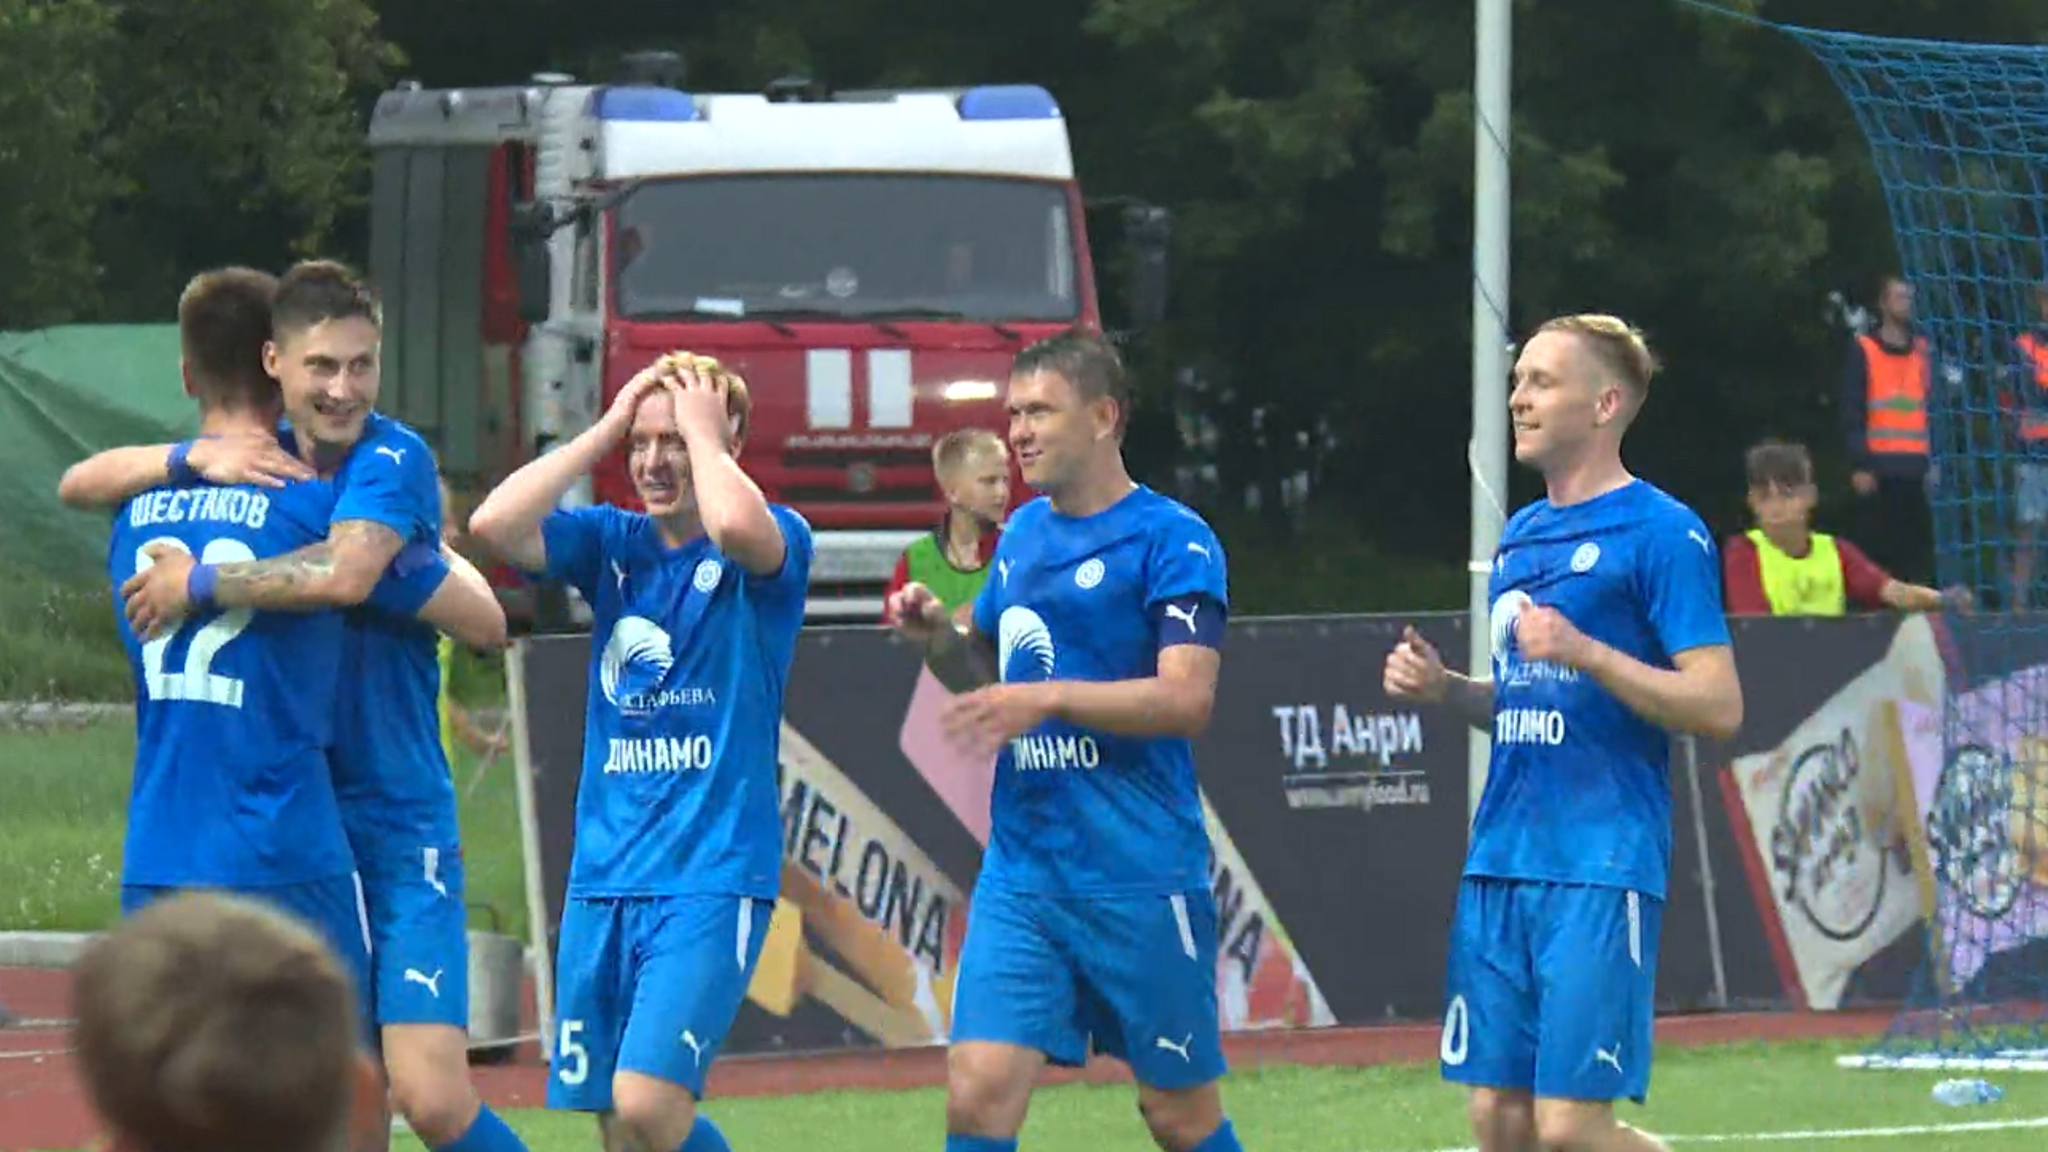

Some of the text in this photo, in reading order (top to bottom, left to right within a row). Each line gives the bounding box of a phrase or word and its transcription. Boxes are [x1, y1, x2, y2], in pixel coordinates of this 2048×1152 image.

[129, 488, 270, 529] ШЕСТАКОВ
[603, 735, 713, 774] ДИНАМО
[1272, 702, 1423, 770] ТД Анри
[559, 1018, 589, 1085] 5
